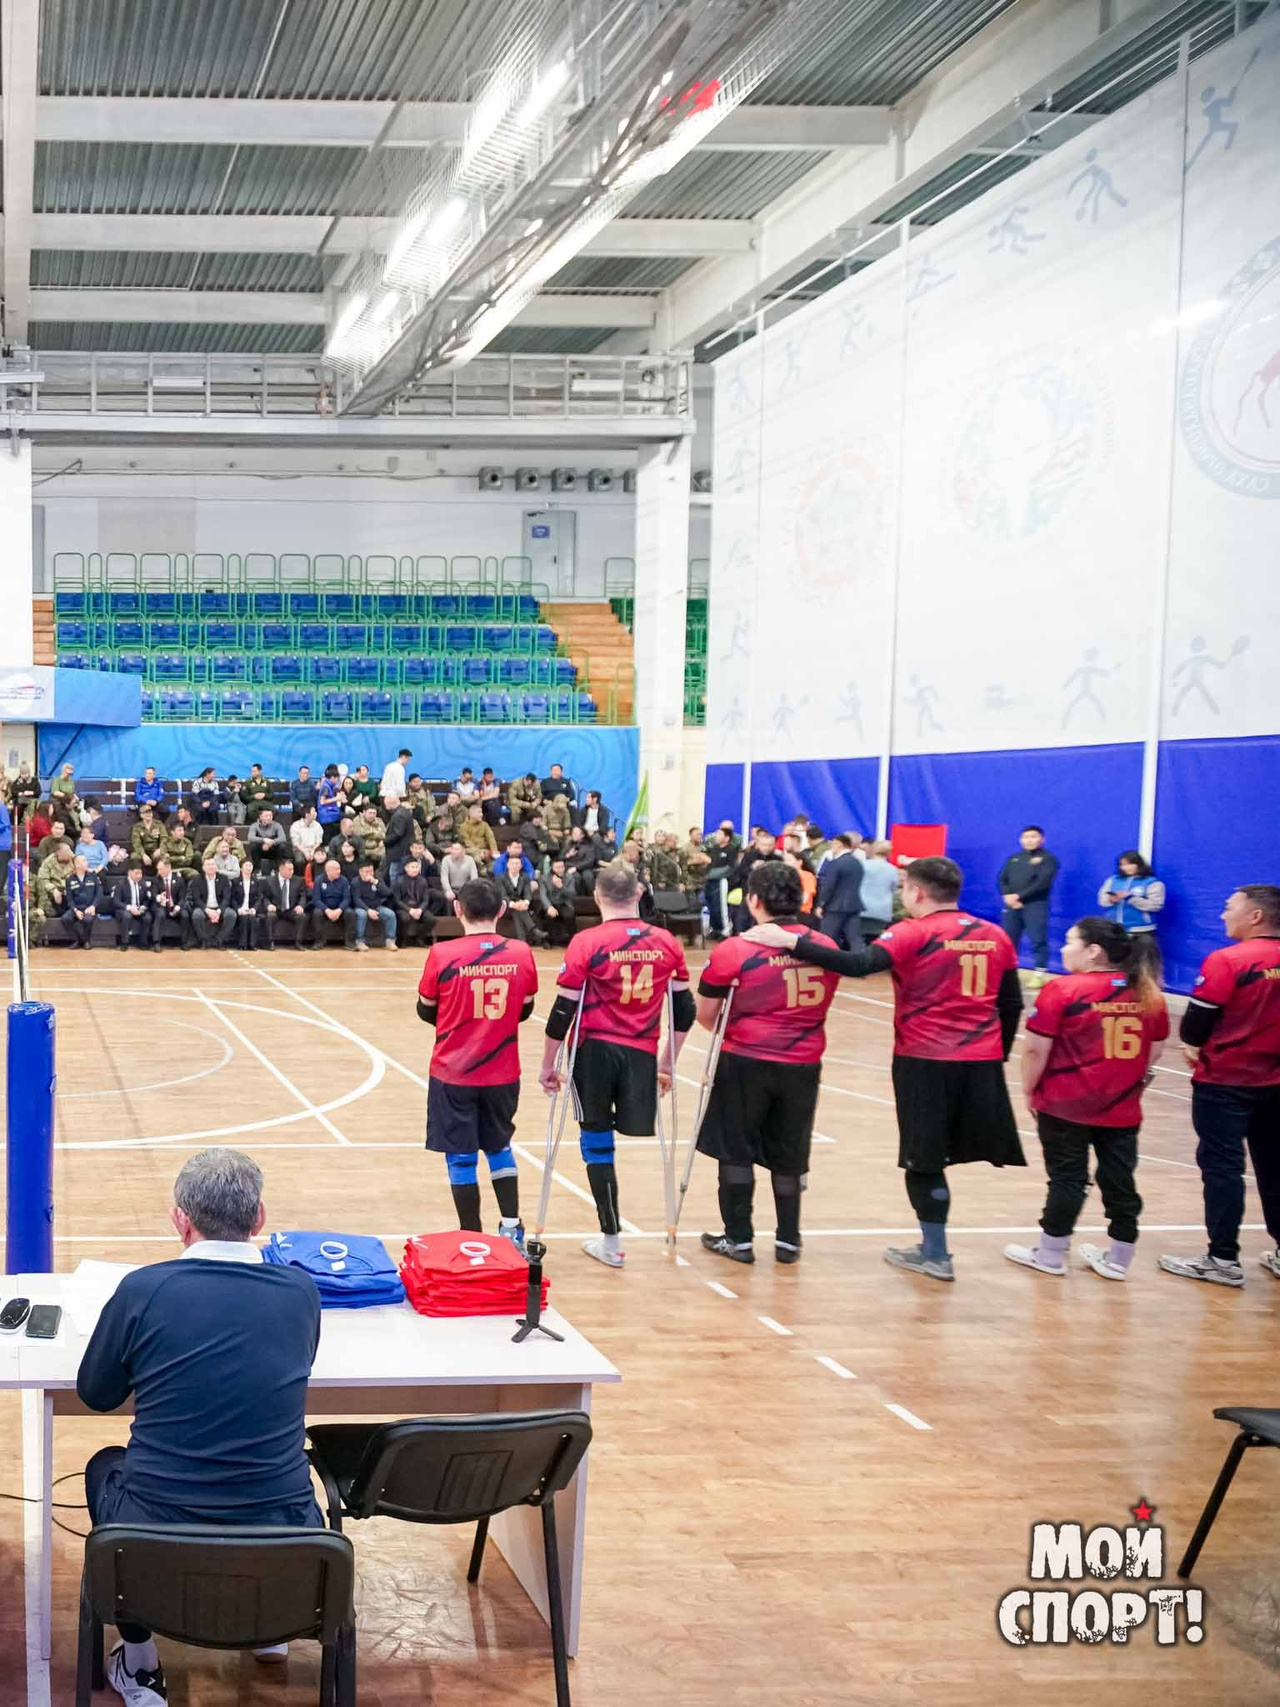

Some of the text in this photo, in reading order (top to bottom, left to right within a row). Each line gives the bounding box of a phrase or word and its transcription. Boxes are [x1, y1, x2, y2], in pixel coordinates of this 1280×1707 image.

[459, 963, 518, 978] МИНСПОРТ
[609, 949, 664, 962] МИНСПОРТ
[959, 954, 988, 997] 11
[470, 978, 510, 1020] 13
[620, 964, 654, 1005] 14
[782, 966, 826, 1008] 15
[1101, 1016, 1143, 1060] 16
